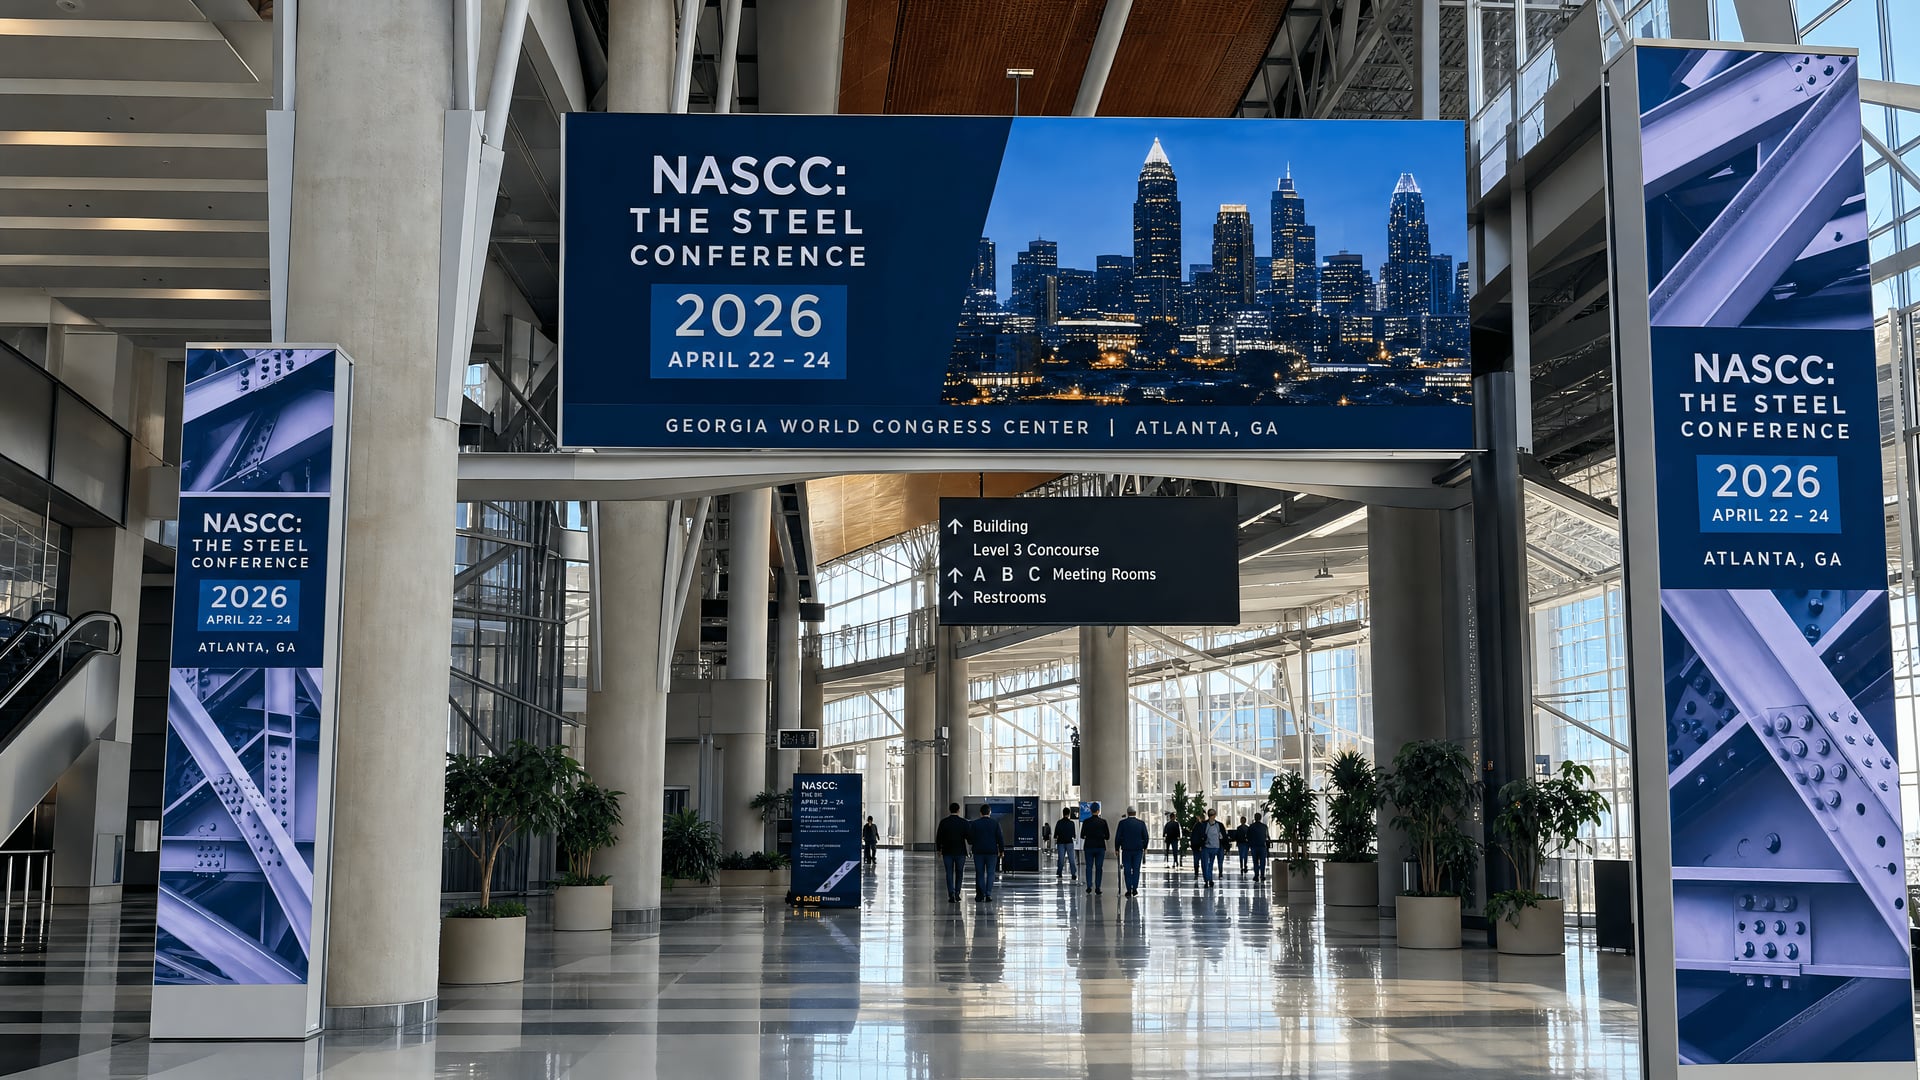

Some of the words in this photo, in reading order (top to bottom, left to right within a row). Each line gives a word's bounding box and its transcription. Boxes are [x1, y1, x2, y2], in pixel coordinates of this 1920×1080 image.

[653, 155, 846, 196] NASCC:
[629, 207, 709, 234] THE
[732, 208, 863, 235] STEEL
[630, 244, 866, 267] CONFERENCE
[675, 293, 822, 338] 2026
[668, 351, 739, 368] APRIL
[748, 351, 775, 368] 22
[803, 351, 830, 368] 24
[1694, 352, 1835, 385] NASCC:
[1679, 393, 1737, 413] THE
[1754, 394, 1846, 415] STEEL
[665, 418, 768, 433] GEORGIA
[780, 419, 860, 434] WORLD
[872, 419, 991, 434] CONGRESS
[1003, 419, 1088, 435] CENTER
[1135, 420, 1239, 438] ATLANTA,
[1250, 420, 1278, 435] GA
[1681, 421, 1850, 439] CONFERENCE
[1716, 463, 1820, 498] 2026
[203, 512, 302, 534] NASCC:
[1712, 508, 1763, 522] APRIL
[1769, 508, 1788, 522] 22
[1809, 509, 1829, 522] 24
[973, 519, 1028, 535] Building
[192, 539, 232, 552] THE
[243, 538, 308, 552] STEEL
[973, 543, 1009, 557] Level
[1013, 543, 1023, 557] 3
[1027, 543, 1100, 557] Concourse
[191, 557, 309, 569] CONFERENCE
[1703, 551, 1804, 569] ATLANTA,
[1814, 551, 1842, 567] GA
[973, 566, 986, 582] A
[1002, 566, 1014, 582] B
[1028, 566, 1041, 582] C
[1053, 567, 1107, 583] Meeting
[1111, 567, 1157, 582] Rooms
[211, 585, 287, 608] 2026
[973, 590, 1047, 604] Restrooms
[206, 614, 244, 625] APRIL
[248, 614, 262, 625] 22
[276, 614, 291, 625] 24
[198, 641, 269, 655] ATLANTA,
[276, 641, 296, 653] GA
[801, 781, 838, 790] NASCC:
